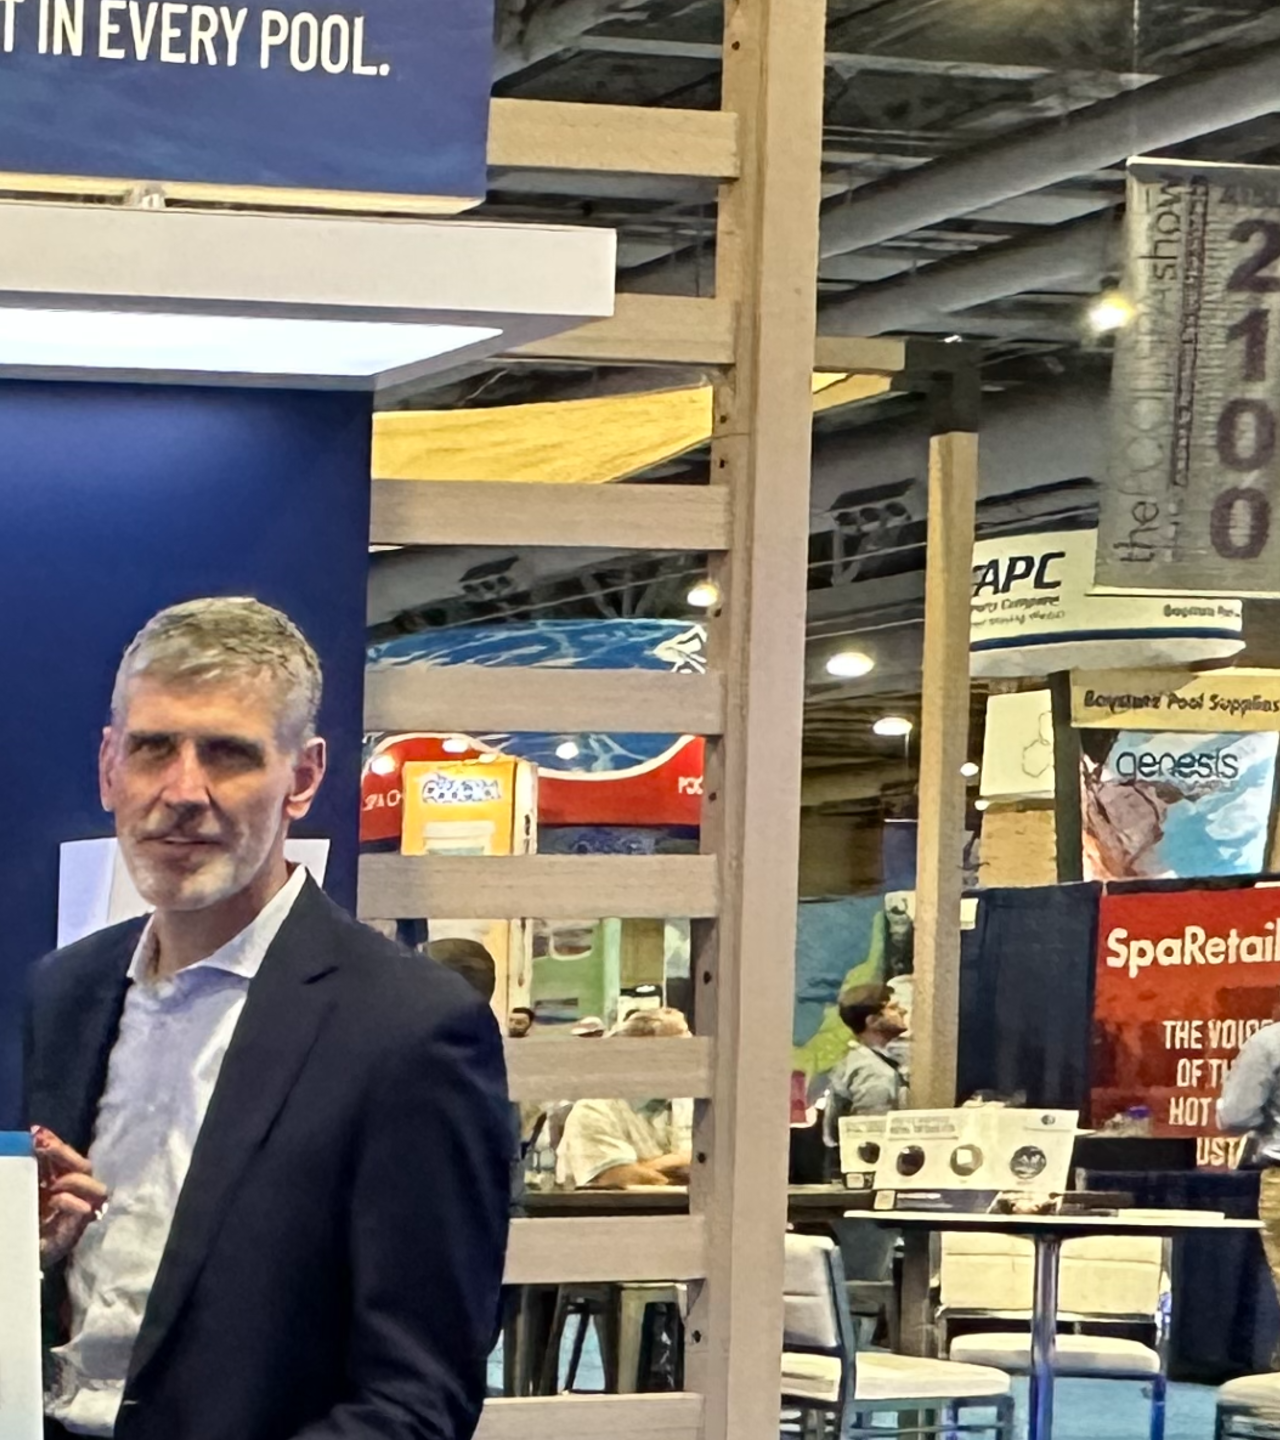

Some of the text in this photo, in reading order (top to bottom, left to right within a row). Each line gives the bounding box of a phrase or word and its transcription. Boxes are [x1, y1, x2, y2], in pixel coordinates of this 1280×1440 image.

[38, 0, 85, 57] IN
[98, 0, 248, 67] EVERY
[260, 10, 391, 77] POOL.
[1115, 750, 1240, 780] genesis
[1163, 1020, 1204, 1050] THE
[1176, 1057, 1204, 1088] OF
[1168, 1096, 1213, 1126] HOT
